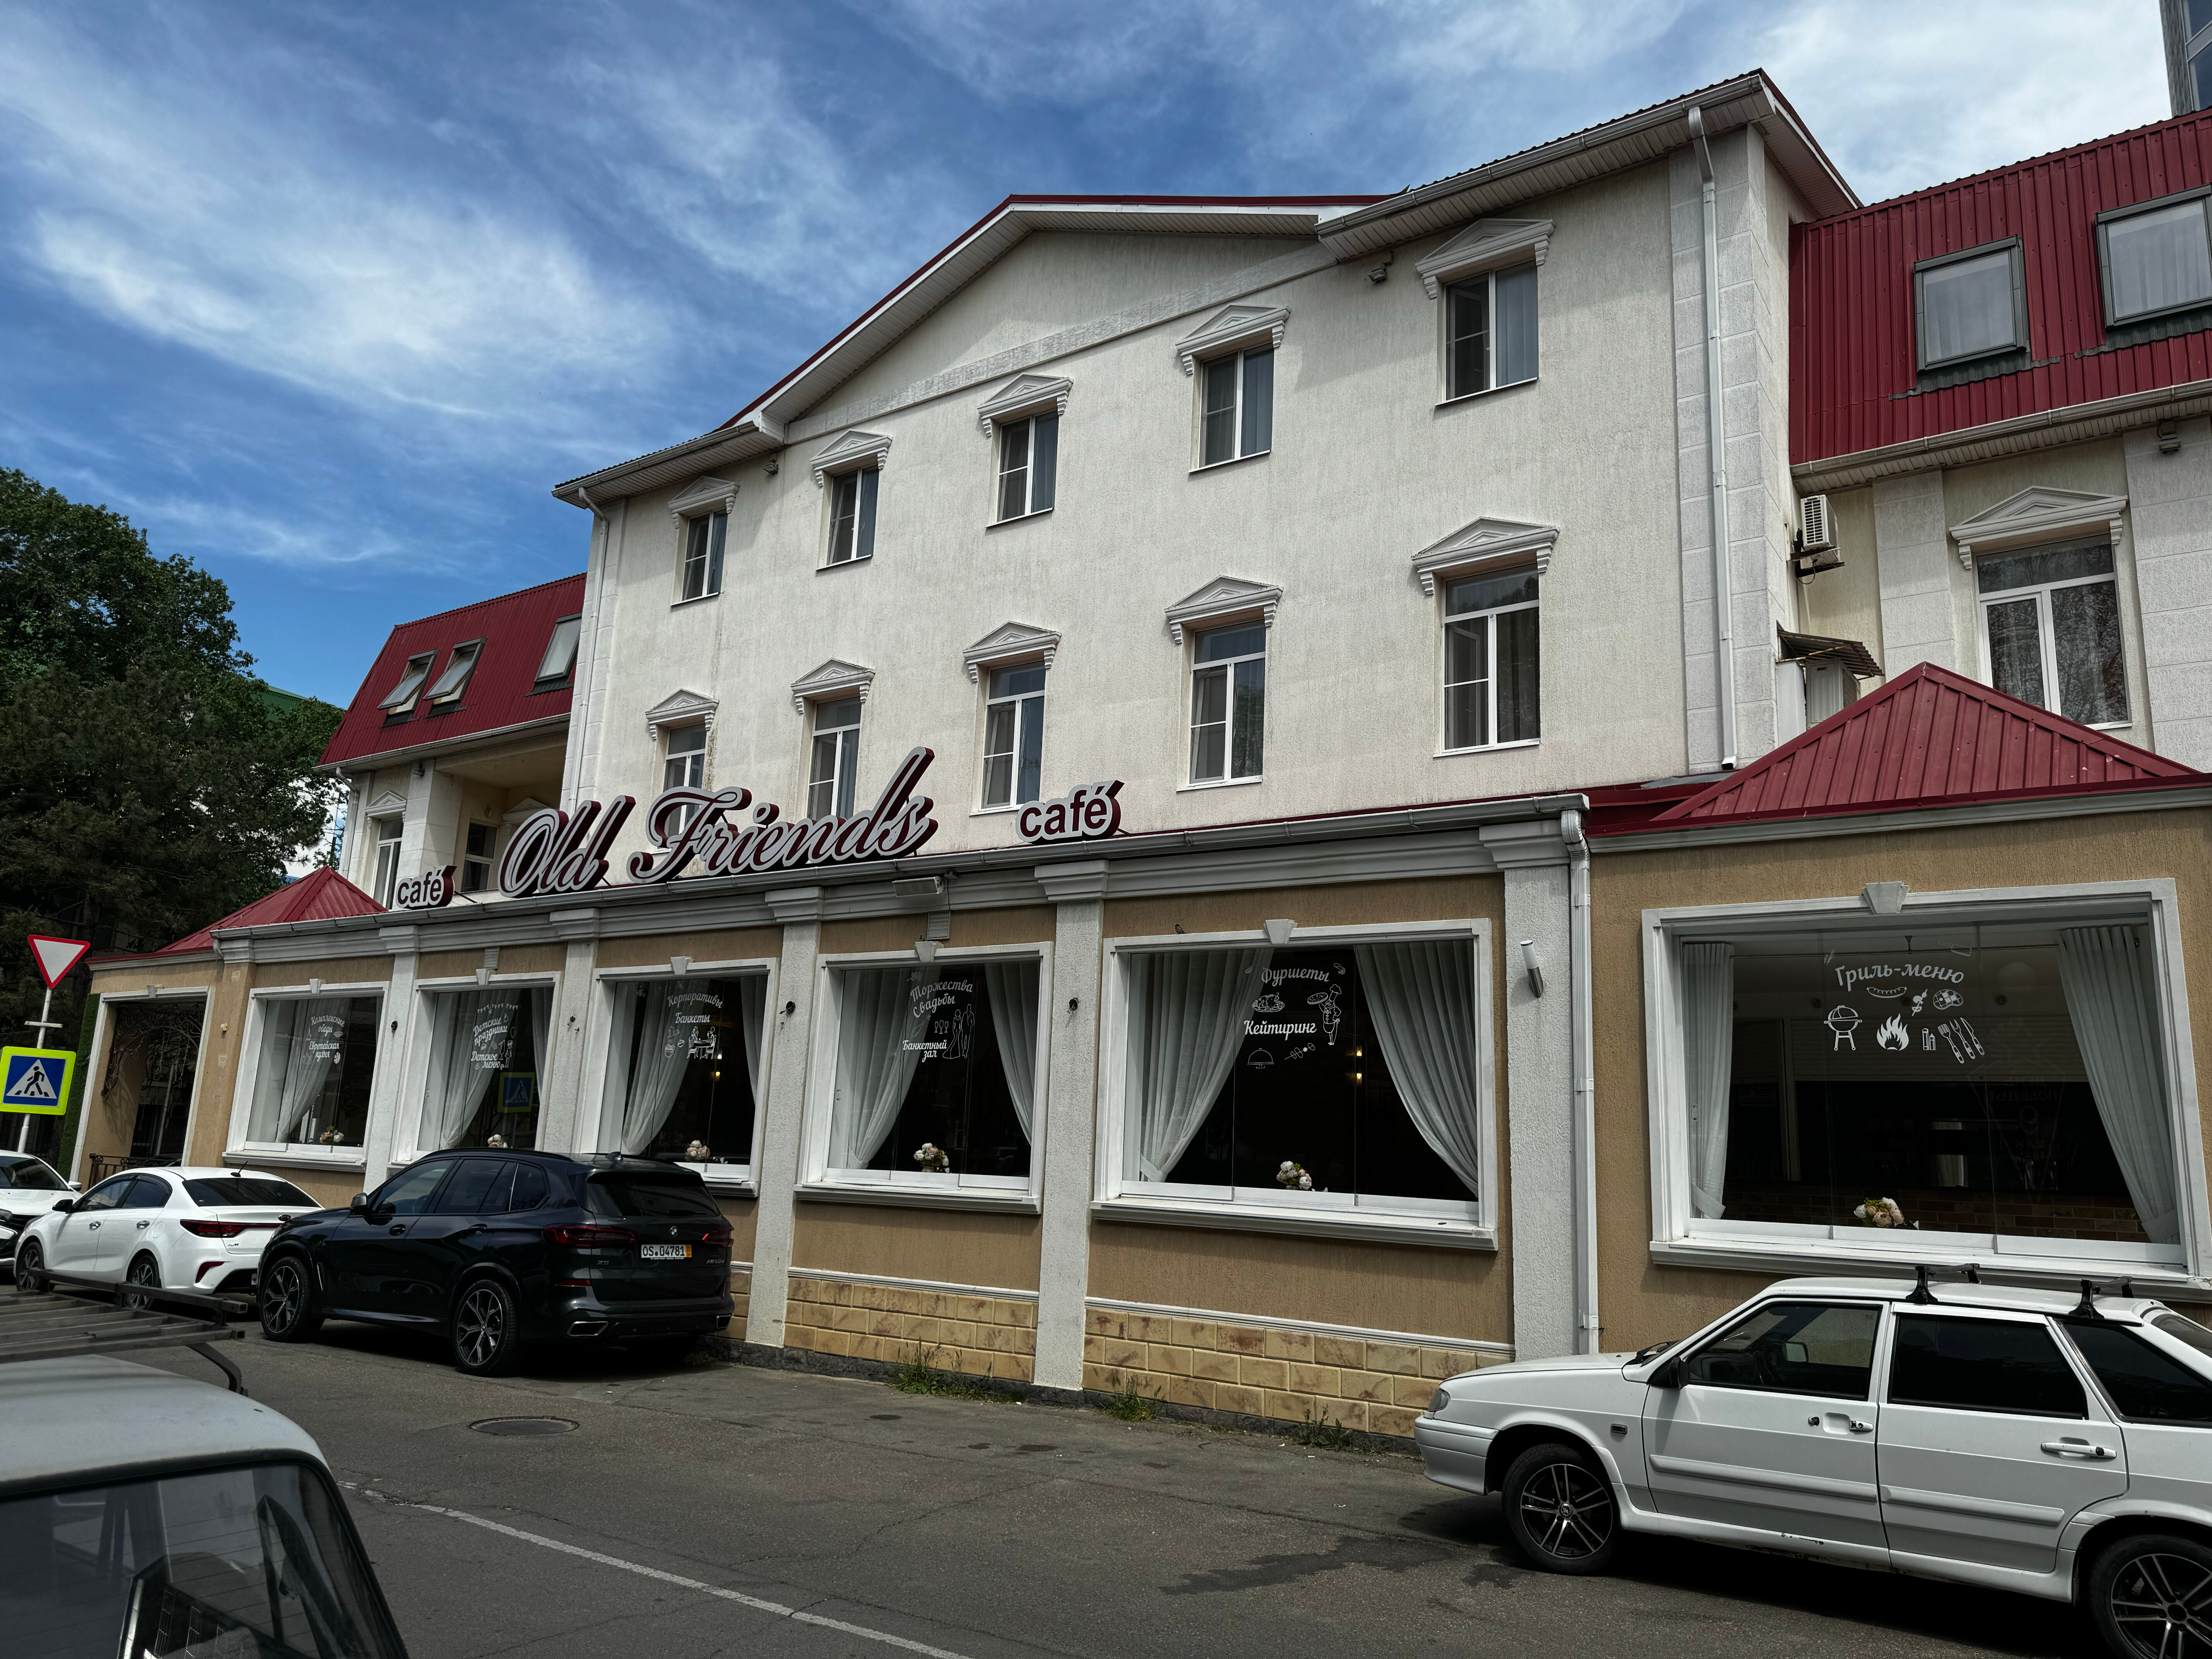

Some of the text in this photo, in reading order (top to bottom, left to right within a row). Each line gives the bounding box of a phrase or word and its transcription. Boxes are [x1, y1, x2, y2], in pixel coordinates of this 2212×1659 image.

[1019, 785, 1108, 838] café
[499, 746, 938, 898] Old Friends
[397, 868, 443, 906] café
[1261, 966, 1329, 987] Фуршеты
[1834, 963, 1964, 992] Гриль-меню
[910, 979, 973, 1002] Торжества
[667, 993, 723, 1008] Корпоративы
[311, 1015, 345, 1027] Комплексные
[675, 1012, 711, 1024] Банкеты
[318, 1024, 333, 1037] обеды
[473, 1018, 502, 1037] Детские
[474, 1025, 508, 1047] праздники
[1244, 1020, 1317, 1041] Кейтиринг
[309, 1041, 339, 1054] Европейская
[902, 1039, 947, 1050] Банкетный
[315, 1051, 330, 1062] кухня
[471, 1051, 498, 1061] Детское
[921, 1050, 937, 1063] зал
